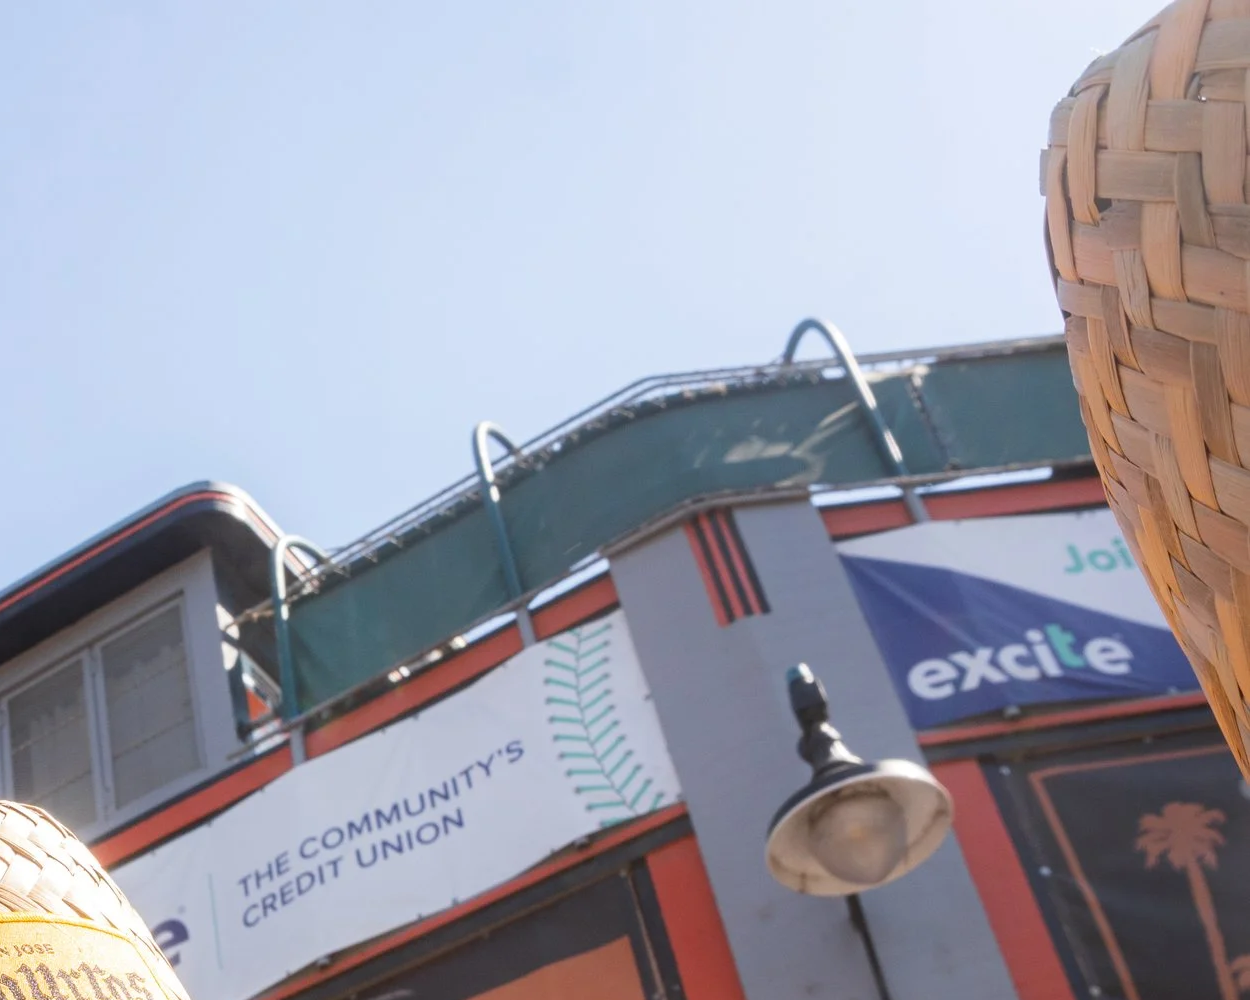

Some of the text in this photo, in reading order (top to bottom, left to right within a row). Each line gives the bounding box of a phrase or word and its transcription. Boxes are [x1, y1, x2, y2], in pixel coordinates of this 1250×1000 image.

[1064, 536, 1135, 574] Joi
[907, 623, 1134, 700] excite
[237, 739, 526, 898] THE COMMUNITY'S
[242, 807, 466, 929] CREDIT UNION
[13, 943, 55, 958] JOSE
